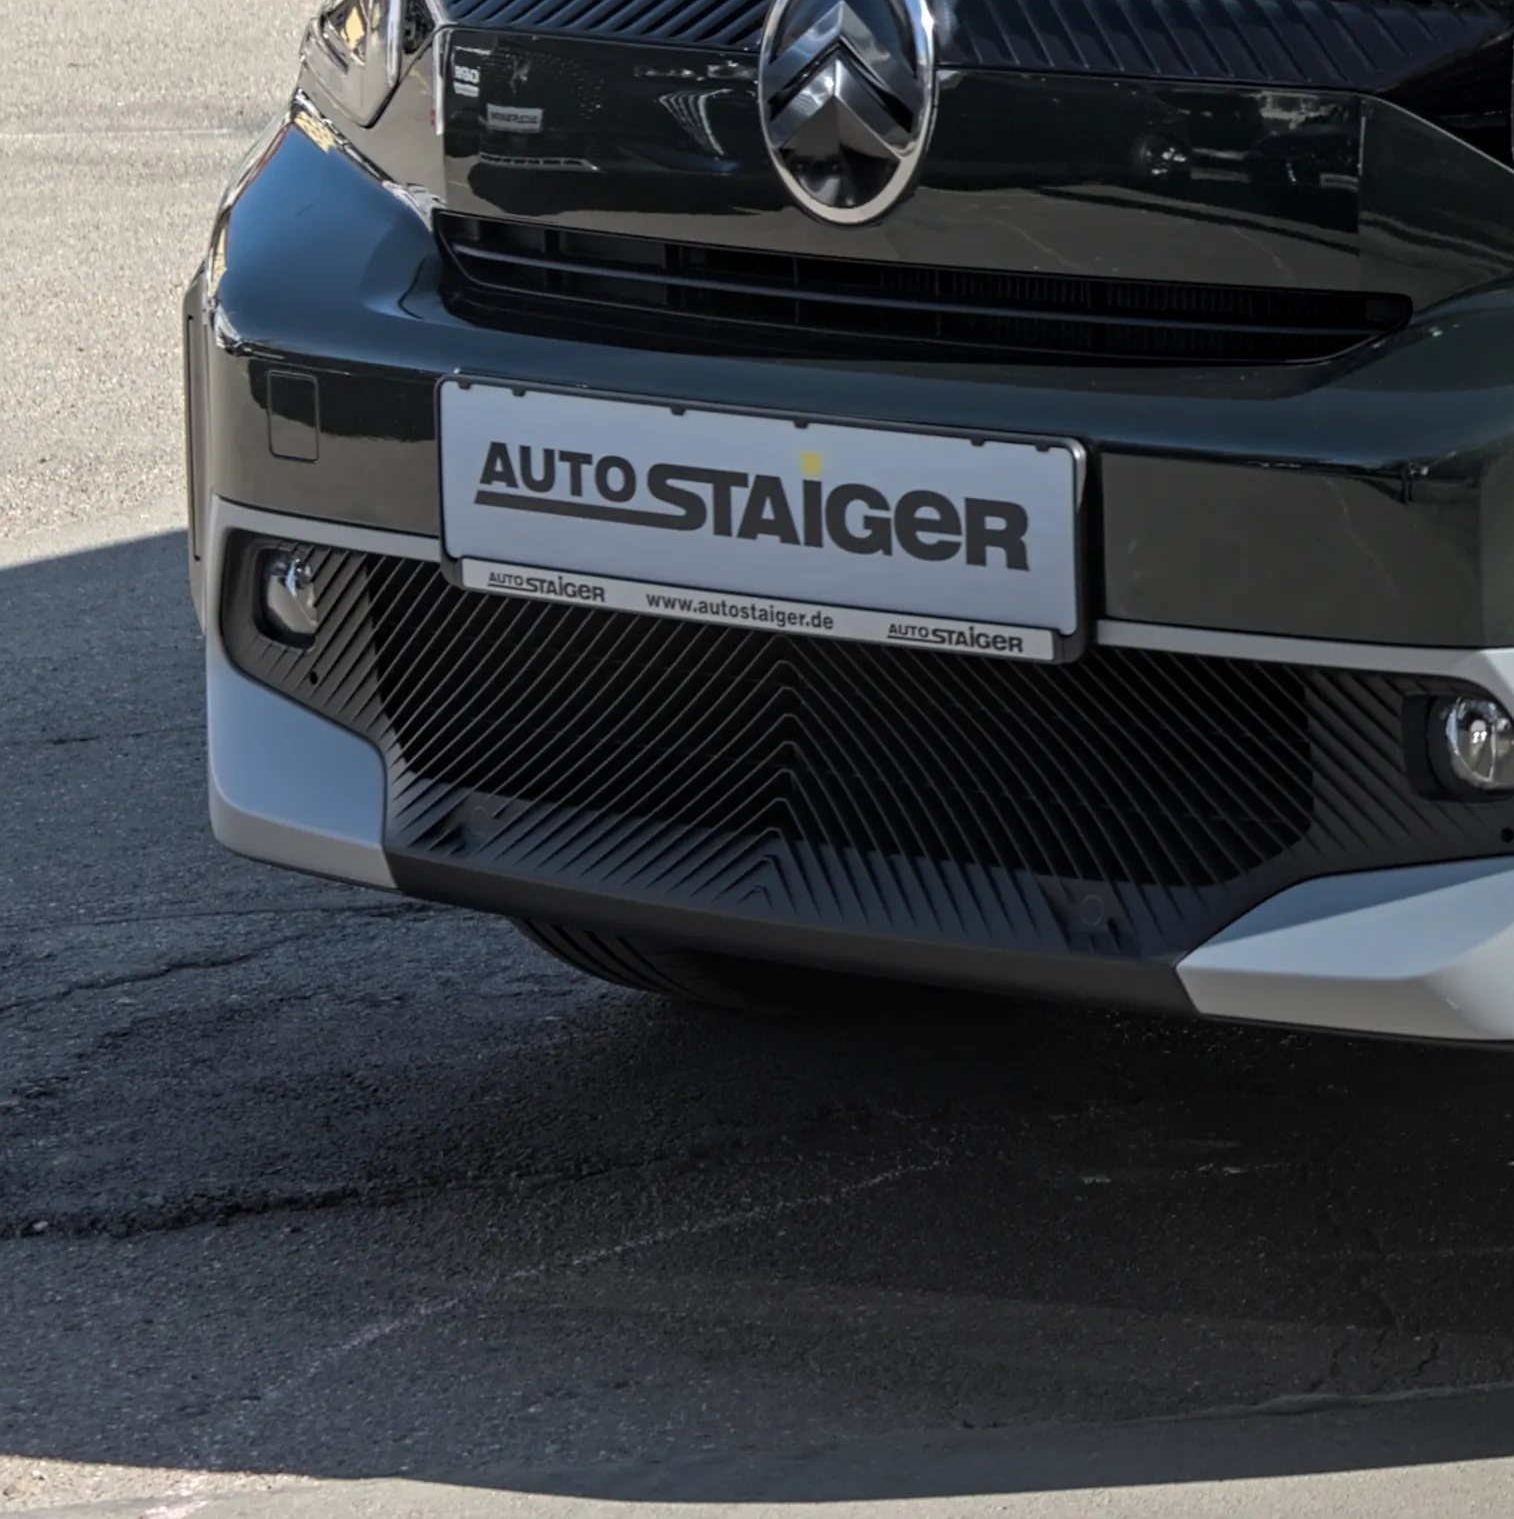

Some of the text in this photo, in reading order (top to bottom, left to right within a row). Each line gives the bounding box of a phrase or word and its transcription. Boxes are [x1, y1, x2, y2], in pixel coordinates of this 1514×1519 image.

[478, 441, 637, 502] AUTO
[488, 571, 524, 588] AUTO
[646, 590, 834, 630] www.autostaiger.de
[888, 623, 929, 640] AUTO
